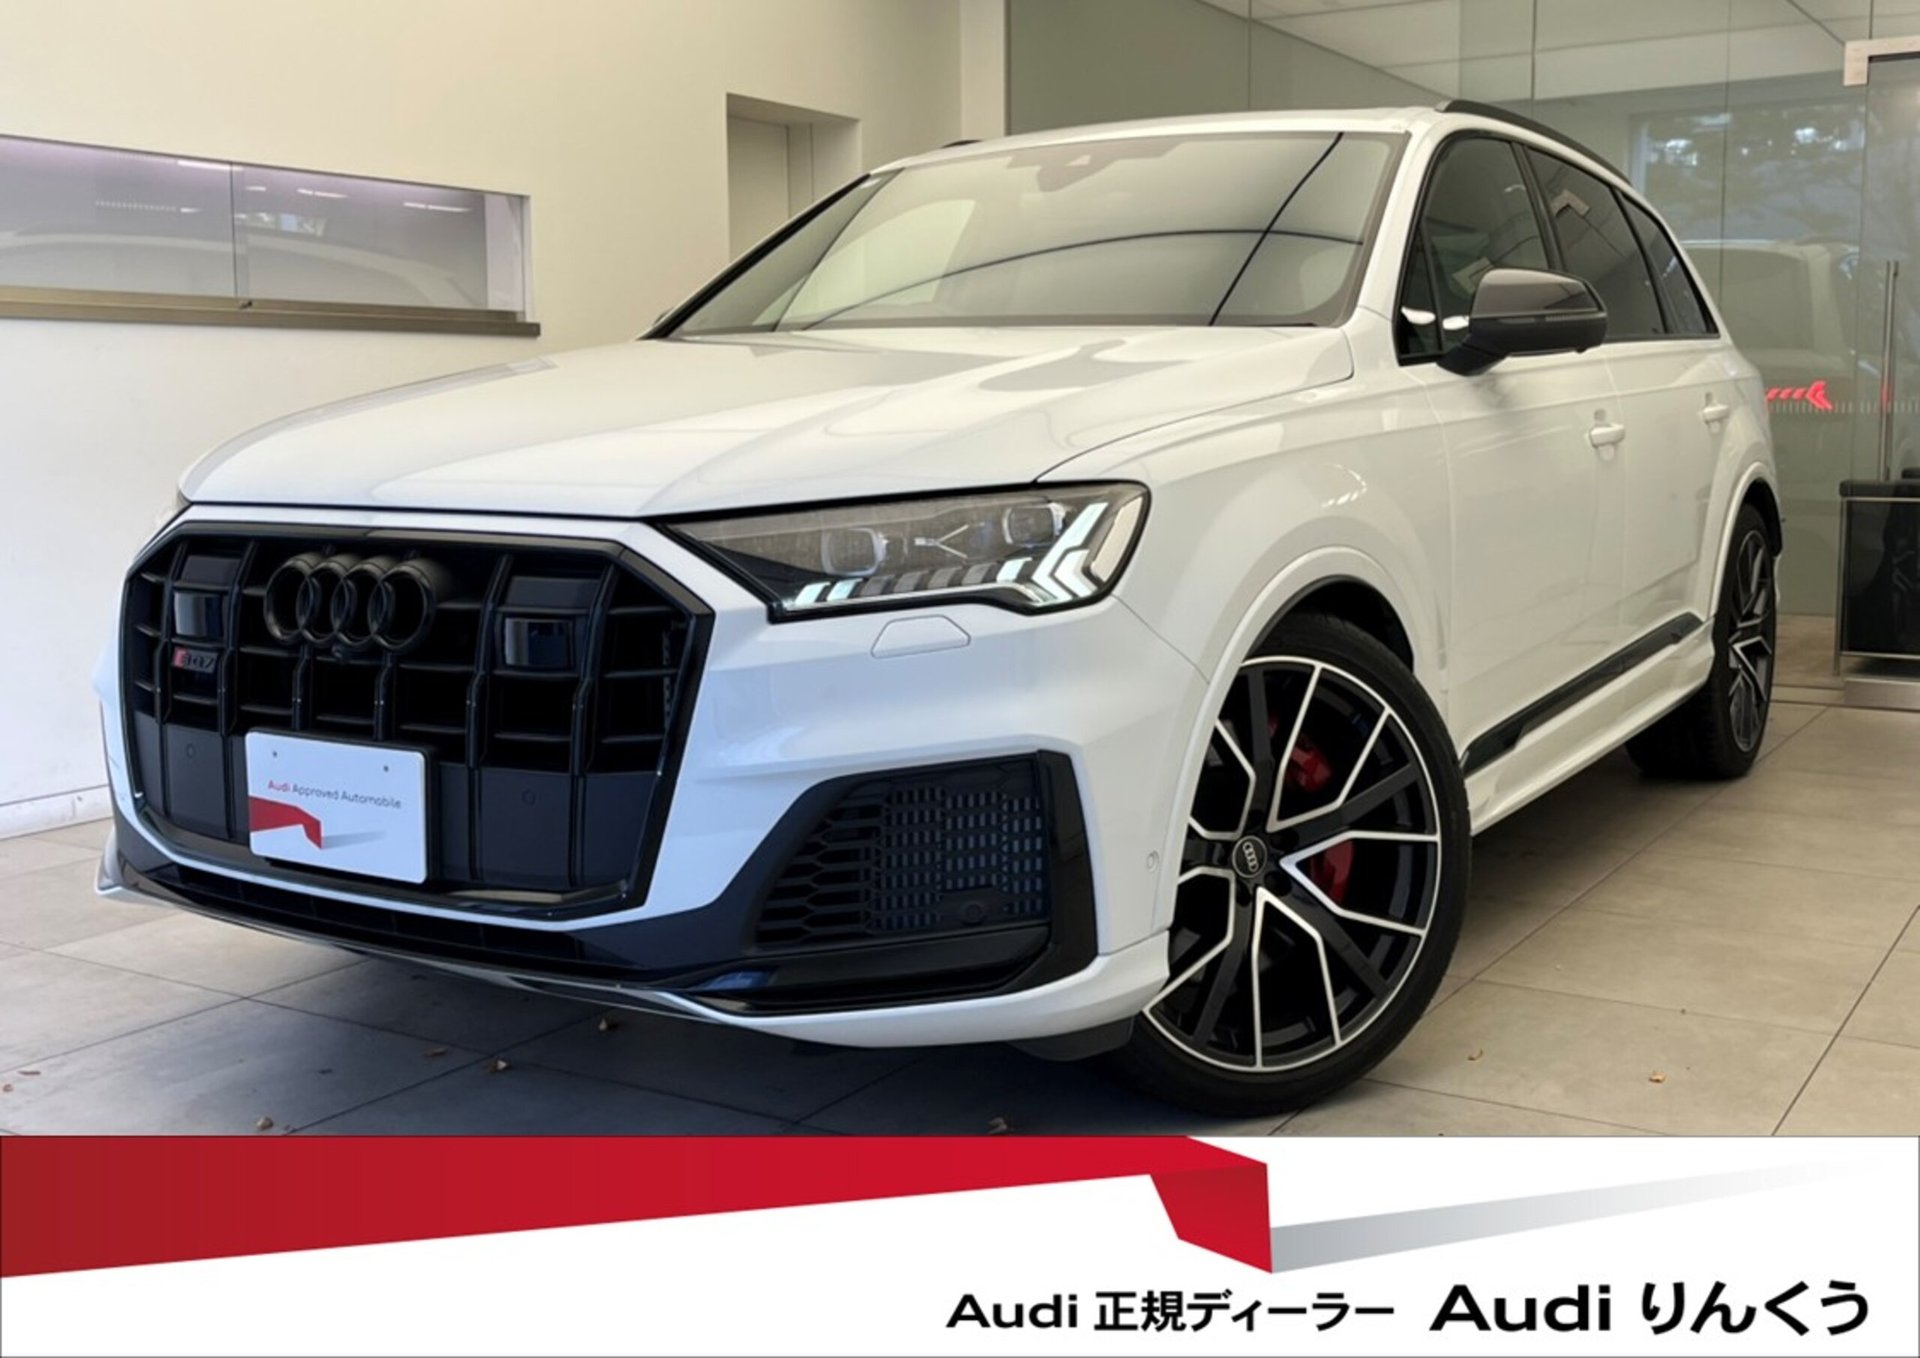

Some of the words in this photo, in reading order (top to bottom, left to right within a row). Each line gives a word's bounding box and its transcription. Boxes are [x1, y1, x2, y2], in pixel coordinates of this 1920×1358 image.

[268, 780, 291, 792] Audi
[292, 783, 339, 800] Approved
[340, 791, 402, 809] Automobile
